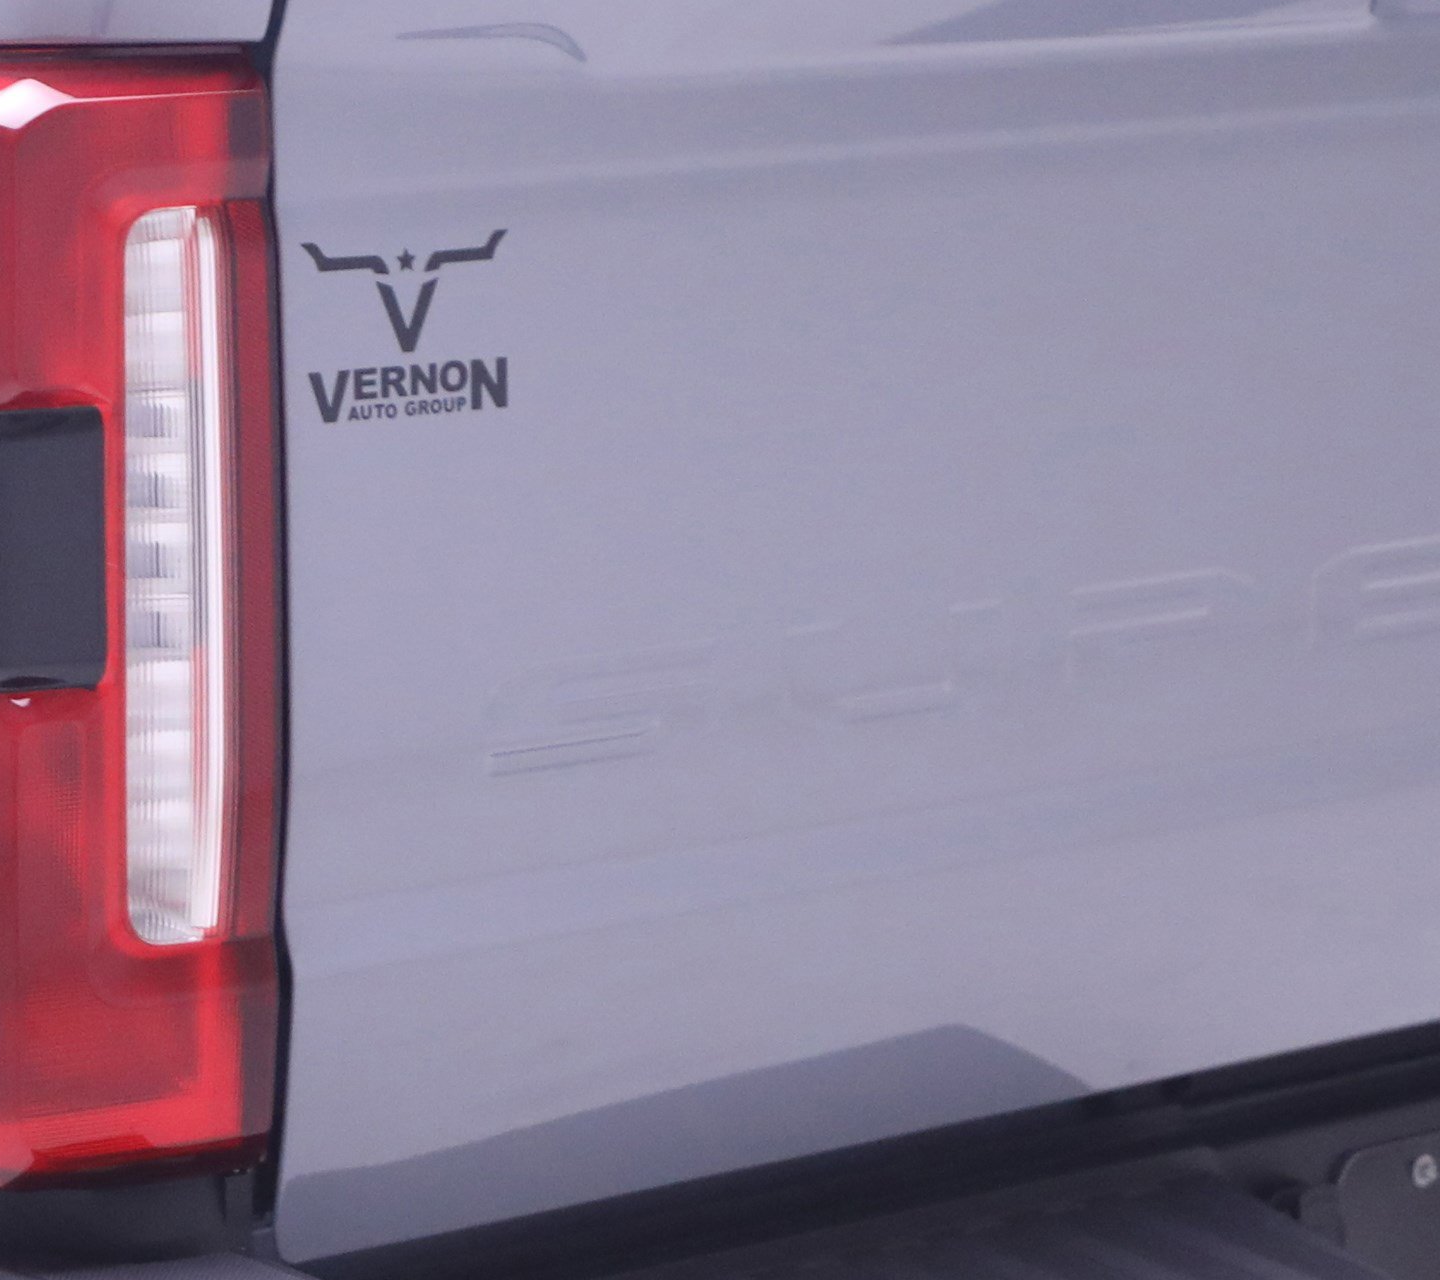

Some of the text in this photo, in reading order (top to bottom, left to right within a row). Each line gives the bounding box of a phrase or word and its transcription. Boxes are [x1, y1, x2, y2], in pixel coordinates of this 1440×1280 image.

[308, 356, 508, 423] VERNON
[347, 396, 467, 422] AUTO GROUP
